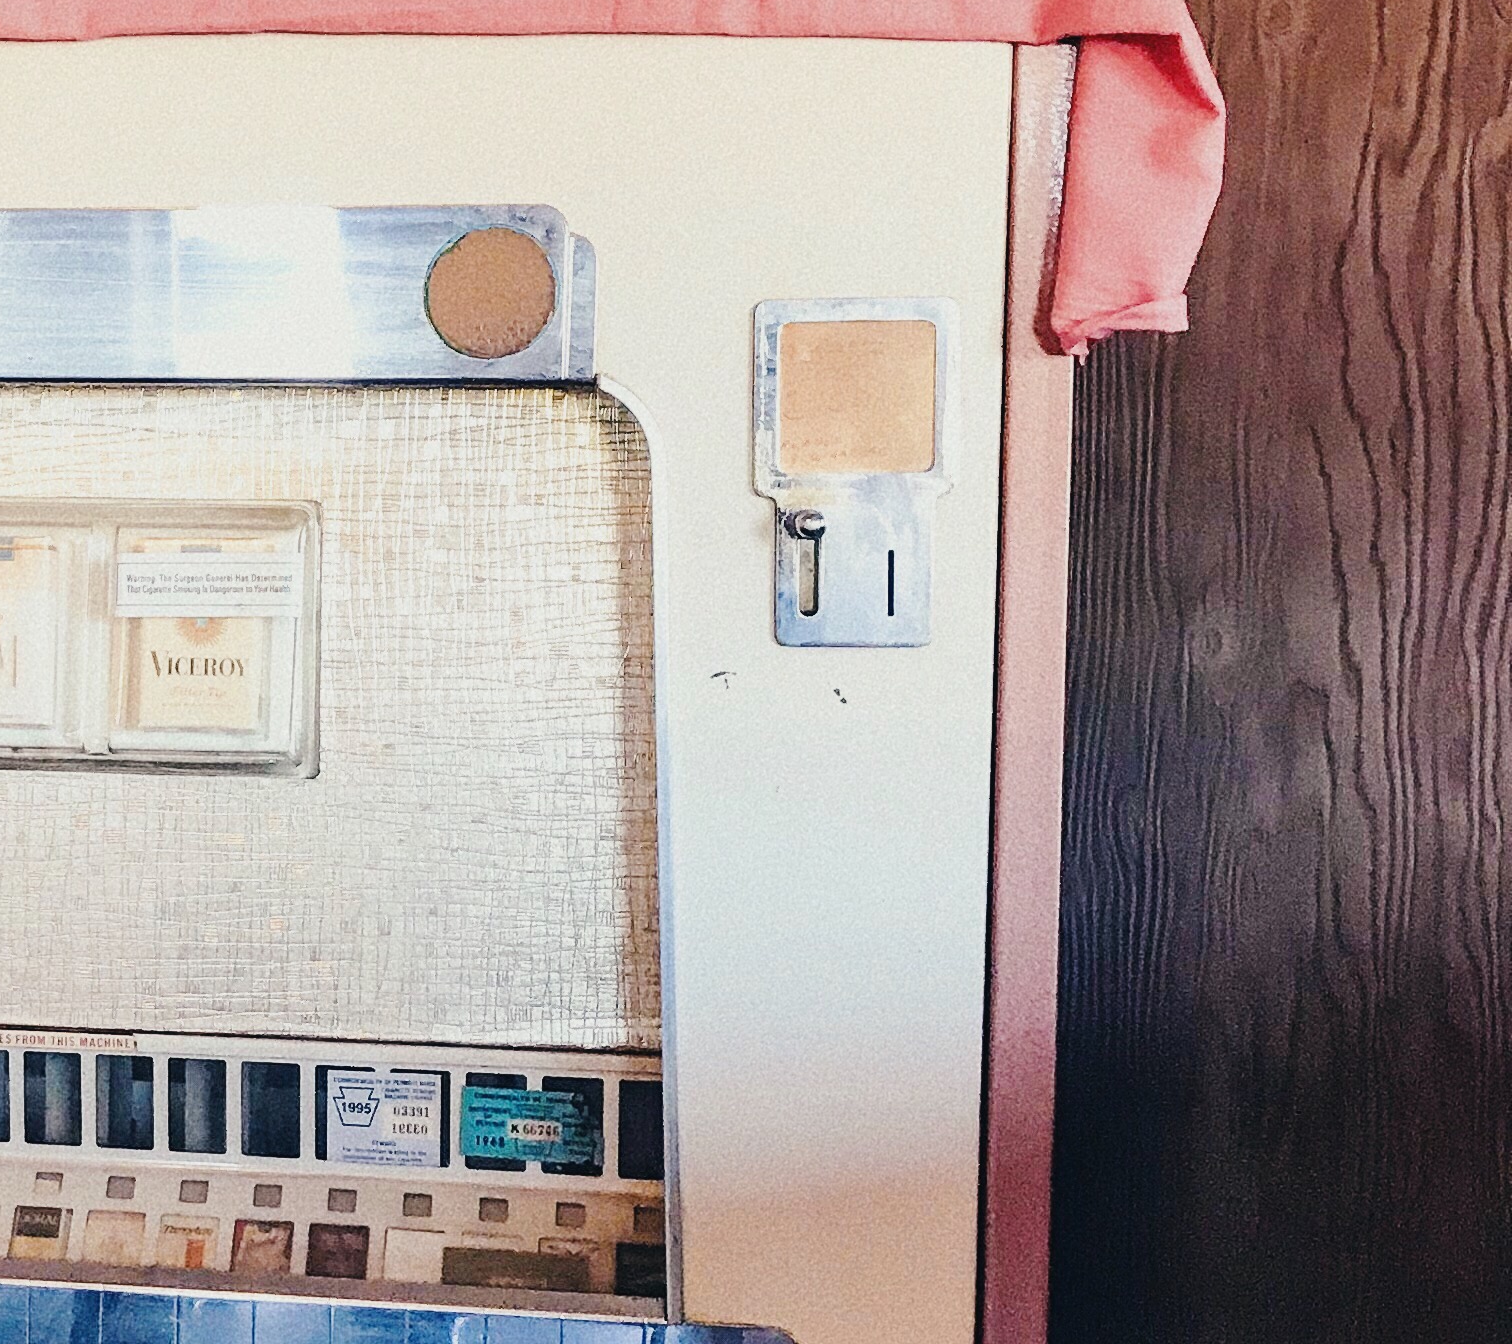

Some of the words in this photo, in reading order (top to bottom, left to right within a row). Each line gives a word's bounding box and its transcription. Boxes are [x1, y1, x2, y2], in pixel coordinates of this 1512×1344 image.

[15, 1033, 47, 1046] FROM
[50, 1035, 75, 1047] THIS
[79, 1036, 131, 1049] MACHINE
[341, 1102, 372, 1115] 1995
